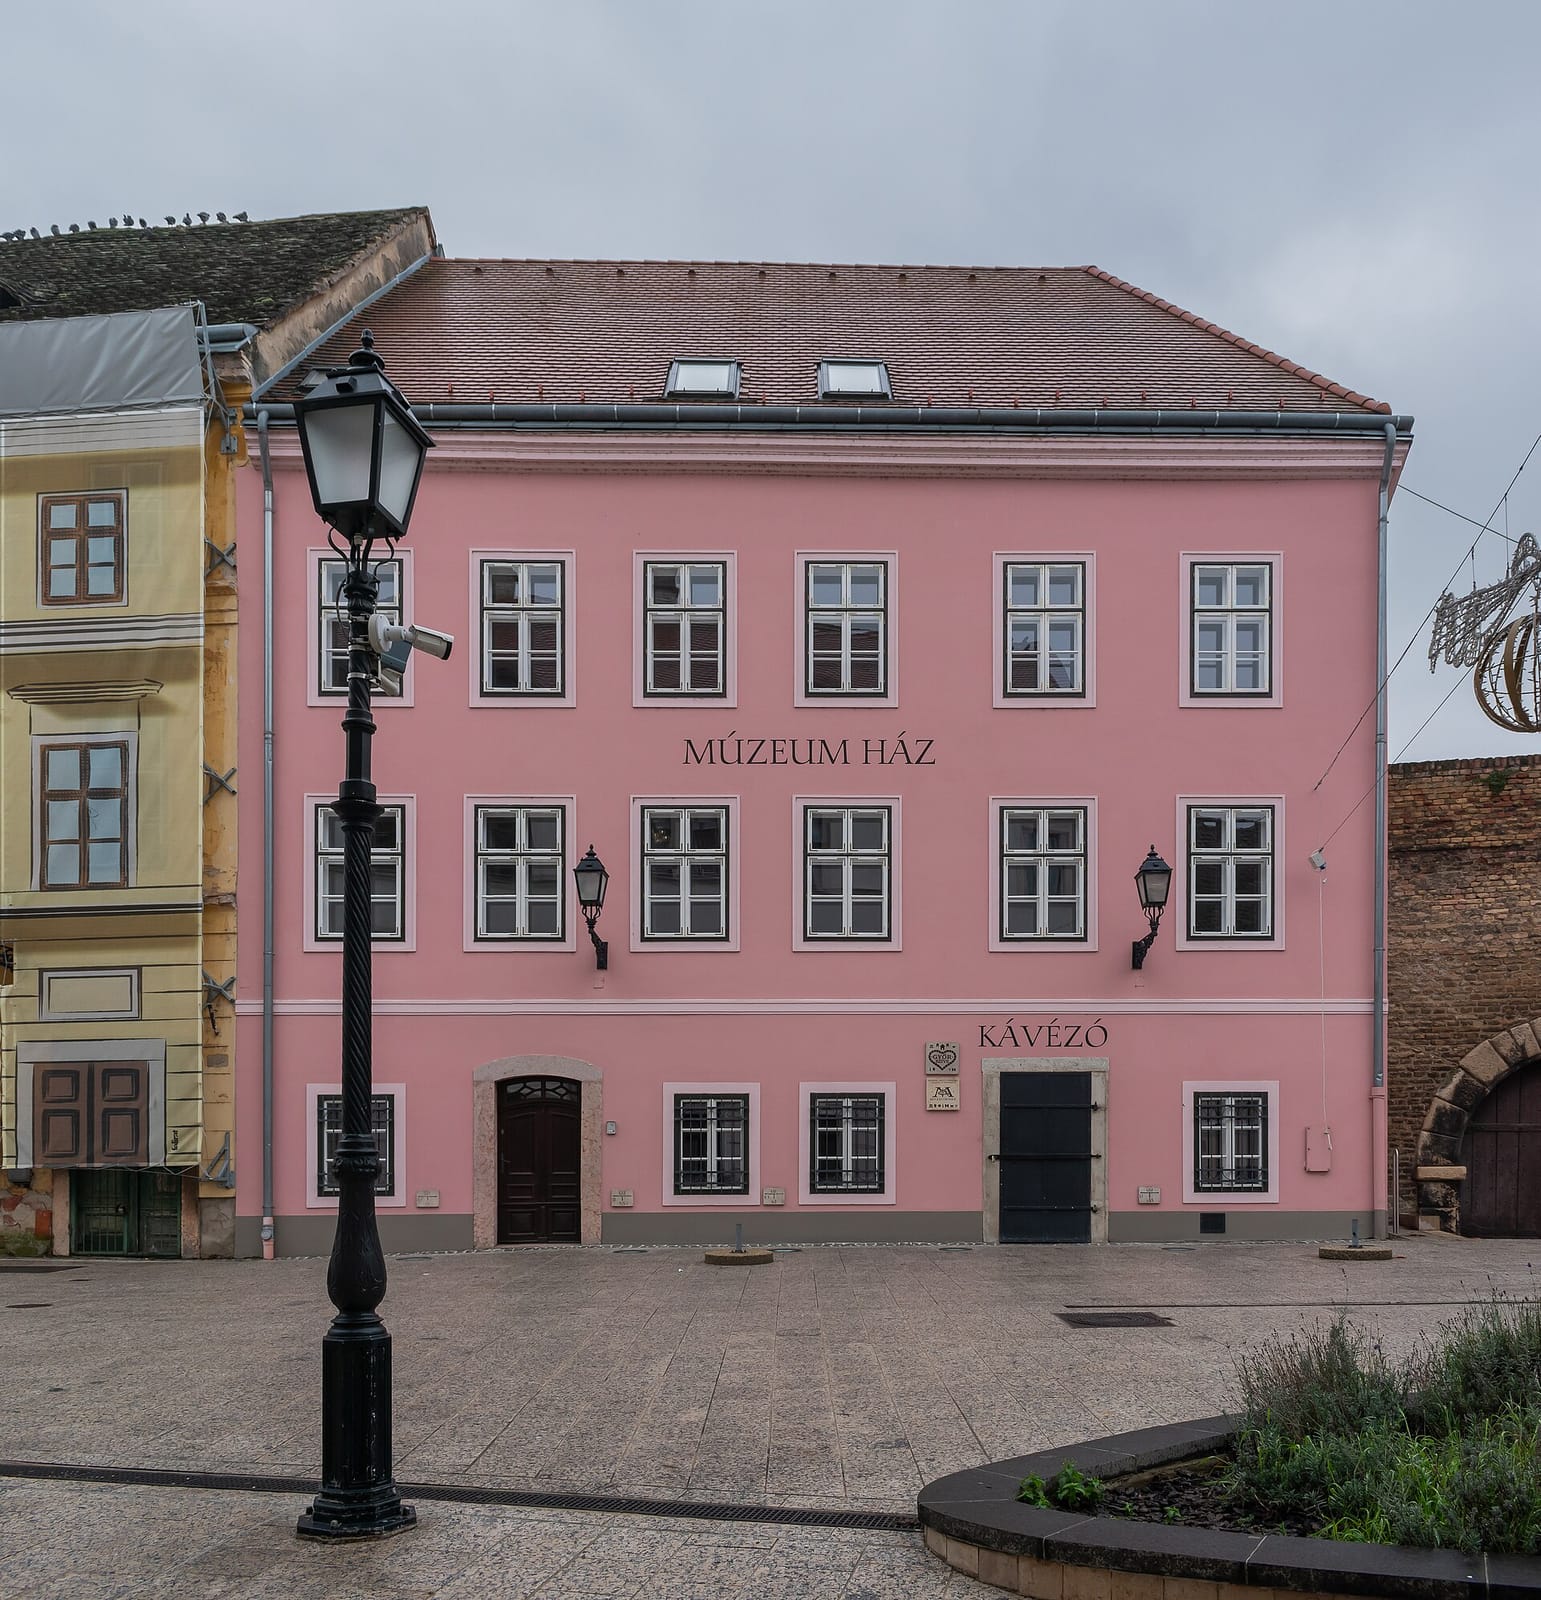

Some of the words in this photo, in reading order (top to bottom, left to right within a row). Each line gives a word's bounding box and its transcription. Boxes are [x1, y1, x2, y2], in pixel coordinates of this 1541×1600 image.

[682, 731, 851, 764] MÚZEUM
[862, 731, 935, 764] HÁZ
[978, 1018, 1107, 1047] KÁVÉZÓ
